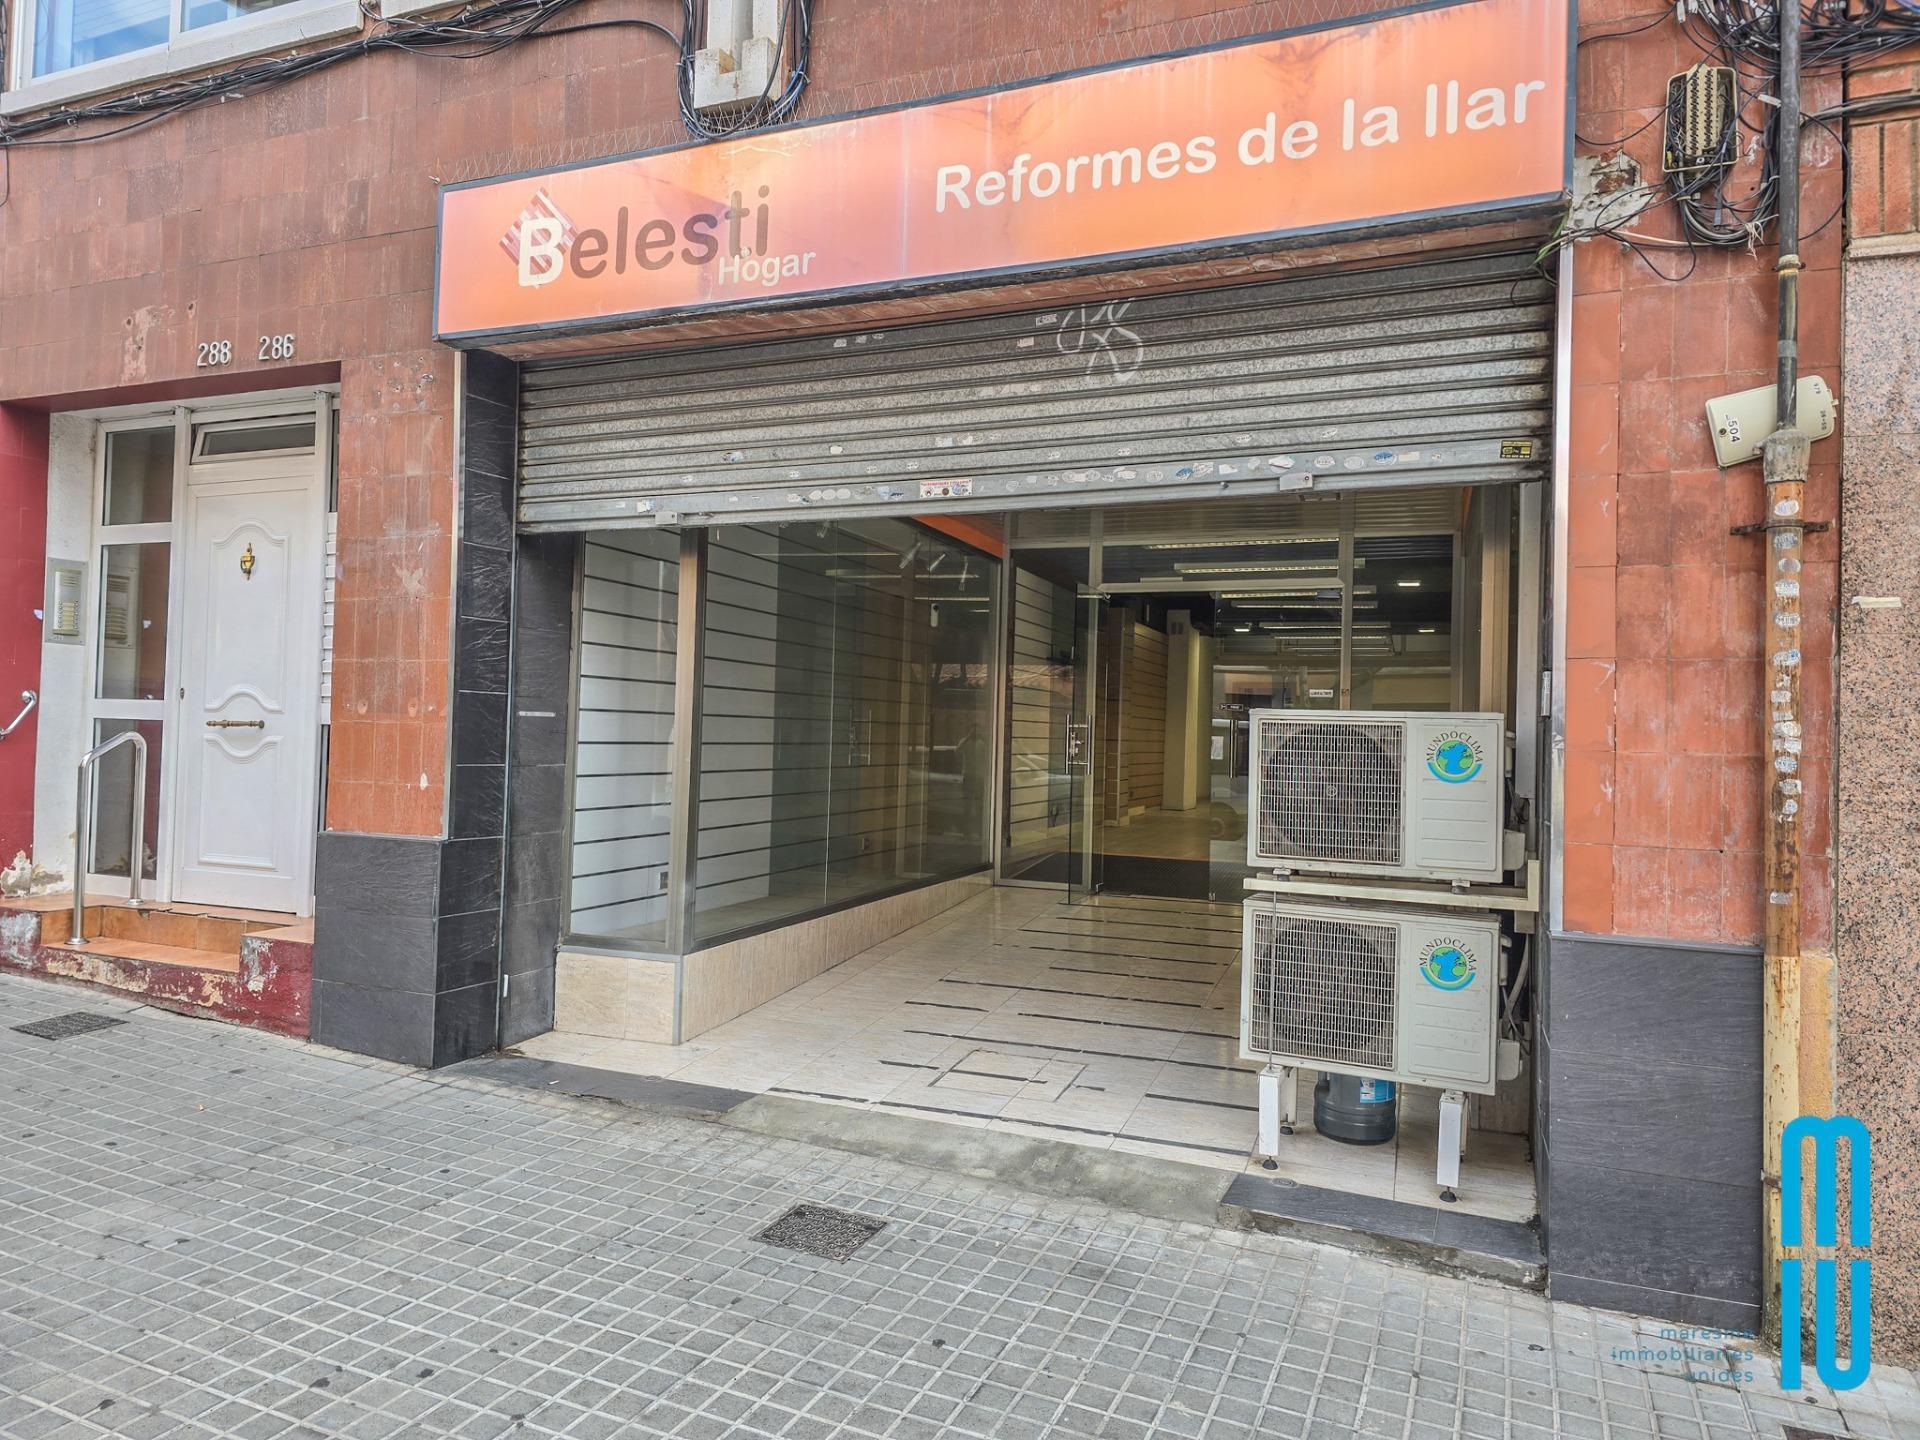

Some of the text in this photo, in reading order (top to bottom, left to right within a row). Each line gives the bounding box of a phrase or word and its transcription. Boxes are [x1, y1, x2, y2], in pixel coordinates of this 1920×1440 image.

[935, 79, 1546, 213] Reformes de la llar
[518, 184, 771, 287] Belesti
[717, 250, 818, 286] Hogar
[196, 334, 295, 367] 288 286
[1728, 420, 1741, 443] 504
[1426, 730, 1484, 763] MUNDOCLIMA
[1419, 936, 1477, 972] MUNDOCLIMA
